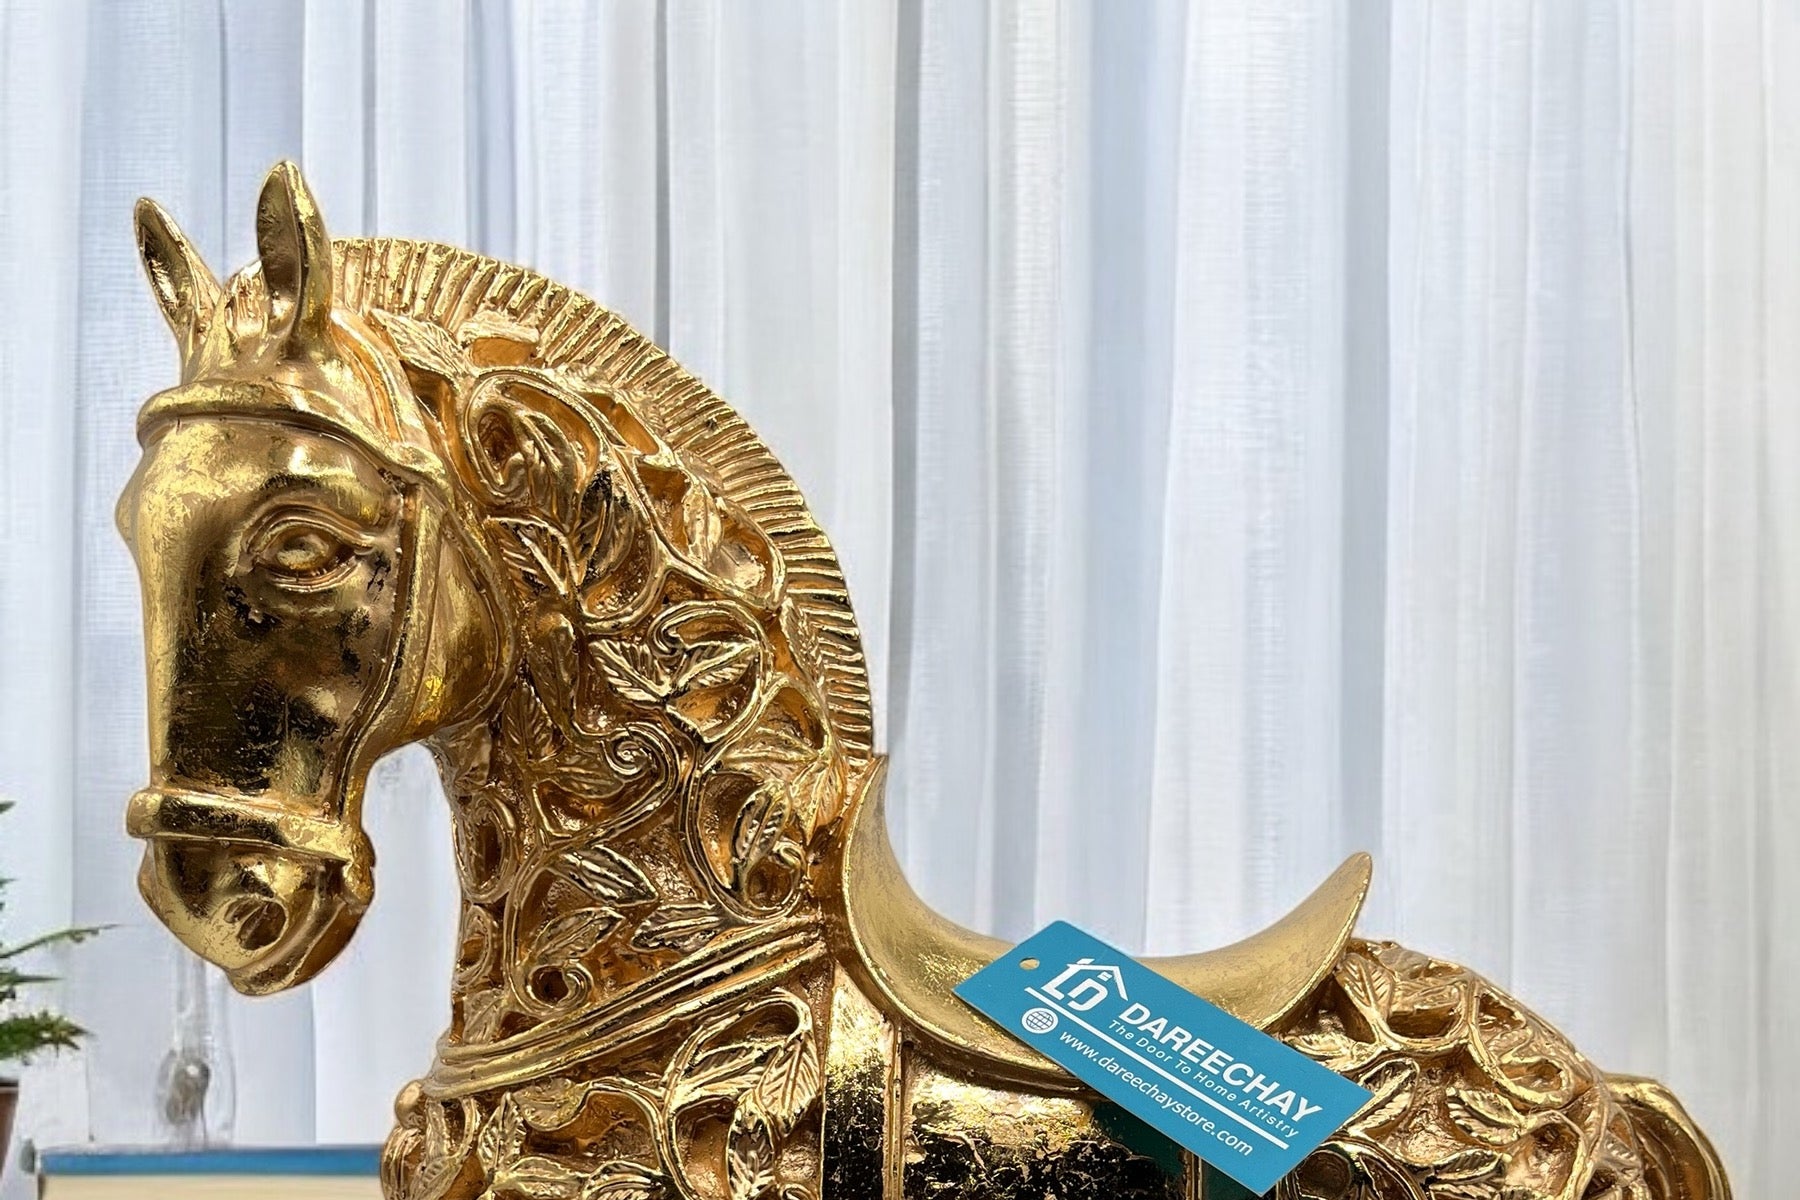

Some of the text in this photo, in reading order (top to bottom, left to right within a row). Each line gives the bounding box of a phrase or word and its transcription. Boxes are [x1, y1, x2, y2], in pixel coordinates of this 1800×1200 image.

[1059, 1031, 1253, 1156] www.dareechaystore.com
[1108, 1019, 1299, 1138] The Door To Home Artistry
[1118, 1002, 1323, 1122] DAREECHAY
